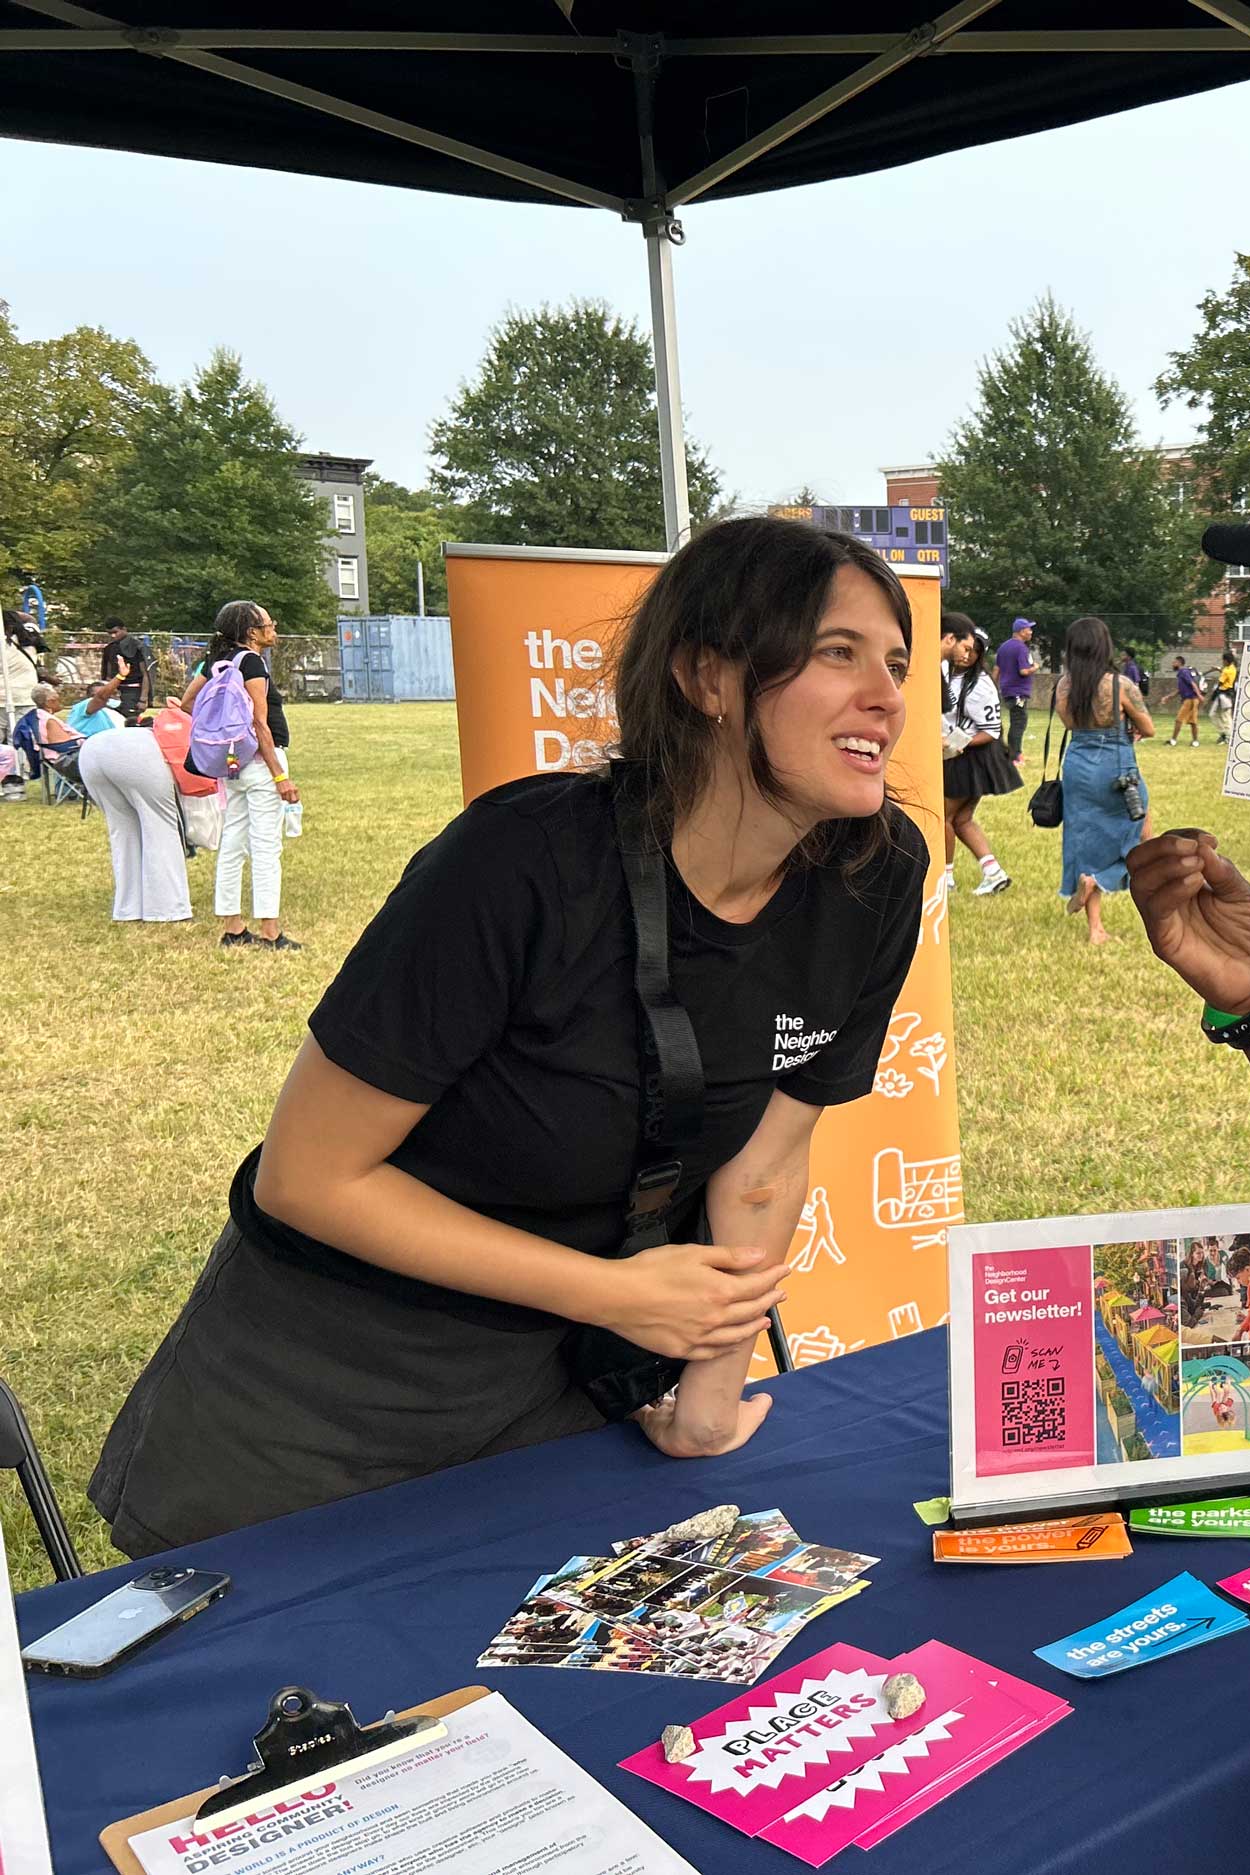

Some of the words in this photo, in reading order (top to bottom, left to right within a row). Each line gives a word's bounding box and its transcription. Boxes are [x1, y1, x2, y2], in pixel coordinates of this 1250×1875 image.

[909, 508, 945, 521] GUEST
[917, 549, 940, 562] QTR
[524, 630, 603, 670] the
[775, 1013, 804, 1030] the
[984, 1289, 1017, 1305] Get
[1020, 1289, 1050, 1302] our
[984, 1302, 1082, 1324] newsletter!
[1030, 1346, 1064, 1357] SCAN
[1027, 1359, 1046, 1369] ME
[1148, 1518, 1185, 1527] are
[1149, 1508, 1184, 1518] the
[958, 1534, 996, 1546] the
[1001, 1529, 1074, 1544] power
[958, 1545, 978, 1553] is
[984, 1542, 1056, 1554] yours.
[1066, 1641, 1107, 1661] the
[1106, 1602, 1178, 1644] streets
[1086, 1649, 1123, 1667] are
[1121, 1620, 1188, 1654] yours.
[721, 1690, 841, 1756] PLACE
[733, 1692, 877, 1779] MATTERS
[354, 1775, 371, 1785] Did
[373, 1767, 390, 1778] you
[390, 1757, 415, 1770] know
[360, 1771, 399, 1791] designer
[401, 1765, 413, 1774] no
[415, 1752, 443, 1768] matter
[445, 1743, 465, 1756] your
[183, 1830, 253, 1862] ASPIRING
[256, 1794, 343, 1833] COMMUNITY
[186, 1799, 354, 1874] DESIGNER!
[233, 1856, 274, 1875] WORLD
[275, 1851, 287, 1859] IS
[289, 1846, 297, 1854] A
[298, 1825, 346, 1850] PRODUCT
[347, 1819, 360, 1829] OF
[363, 1803, 399, 1822] DESIGN
